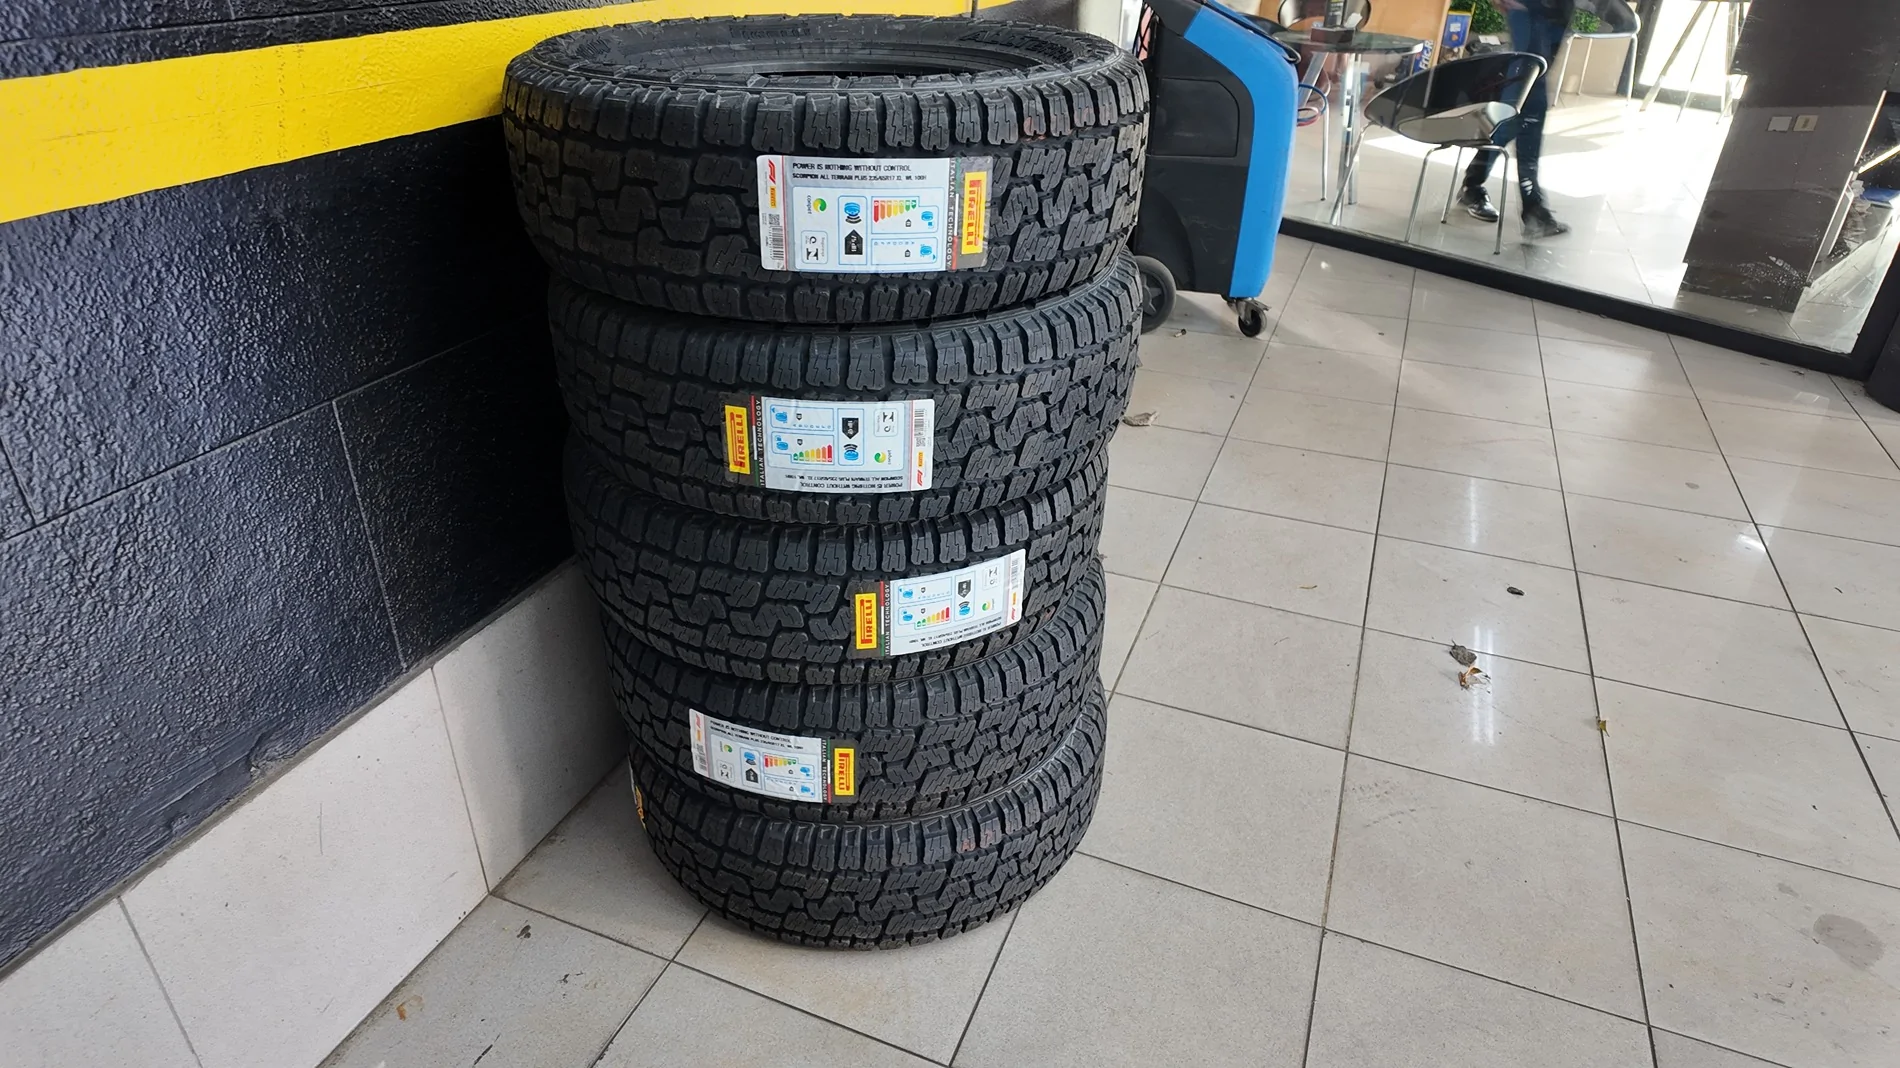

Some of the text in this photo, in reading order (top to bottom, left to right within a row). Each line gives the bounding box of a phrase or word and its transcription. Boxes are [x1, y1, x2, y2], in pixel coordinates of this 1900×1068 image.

[792, 162, 815, 170] POWER
[854, 164, 882, 172] WITHOUT
[966, 179, 982, 246] PIRELLI
[729, 412, 745, 468] PIRELLI
[755, 399, 763, 451] TECHNOLOGY
[859, 599, 873, 645] PIRELLI
[750, 731, 770, 739] WITHOUT
[838, 752, 851, 792] PIRELLI
